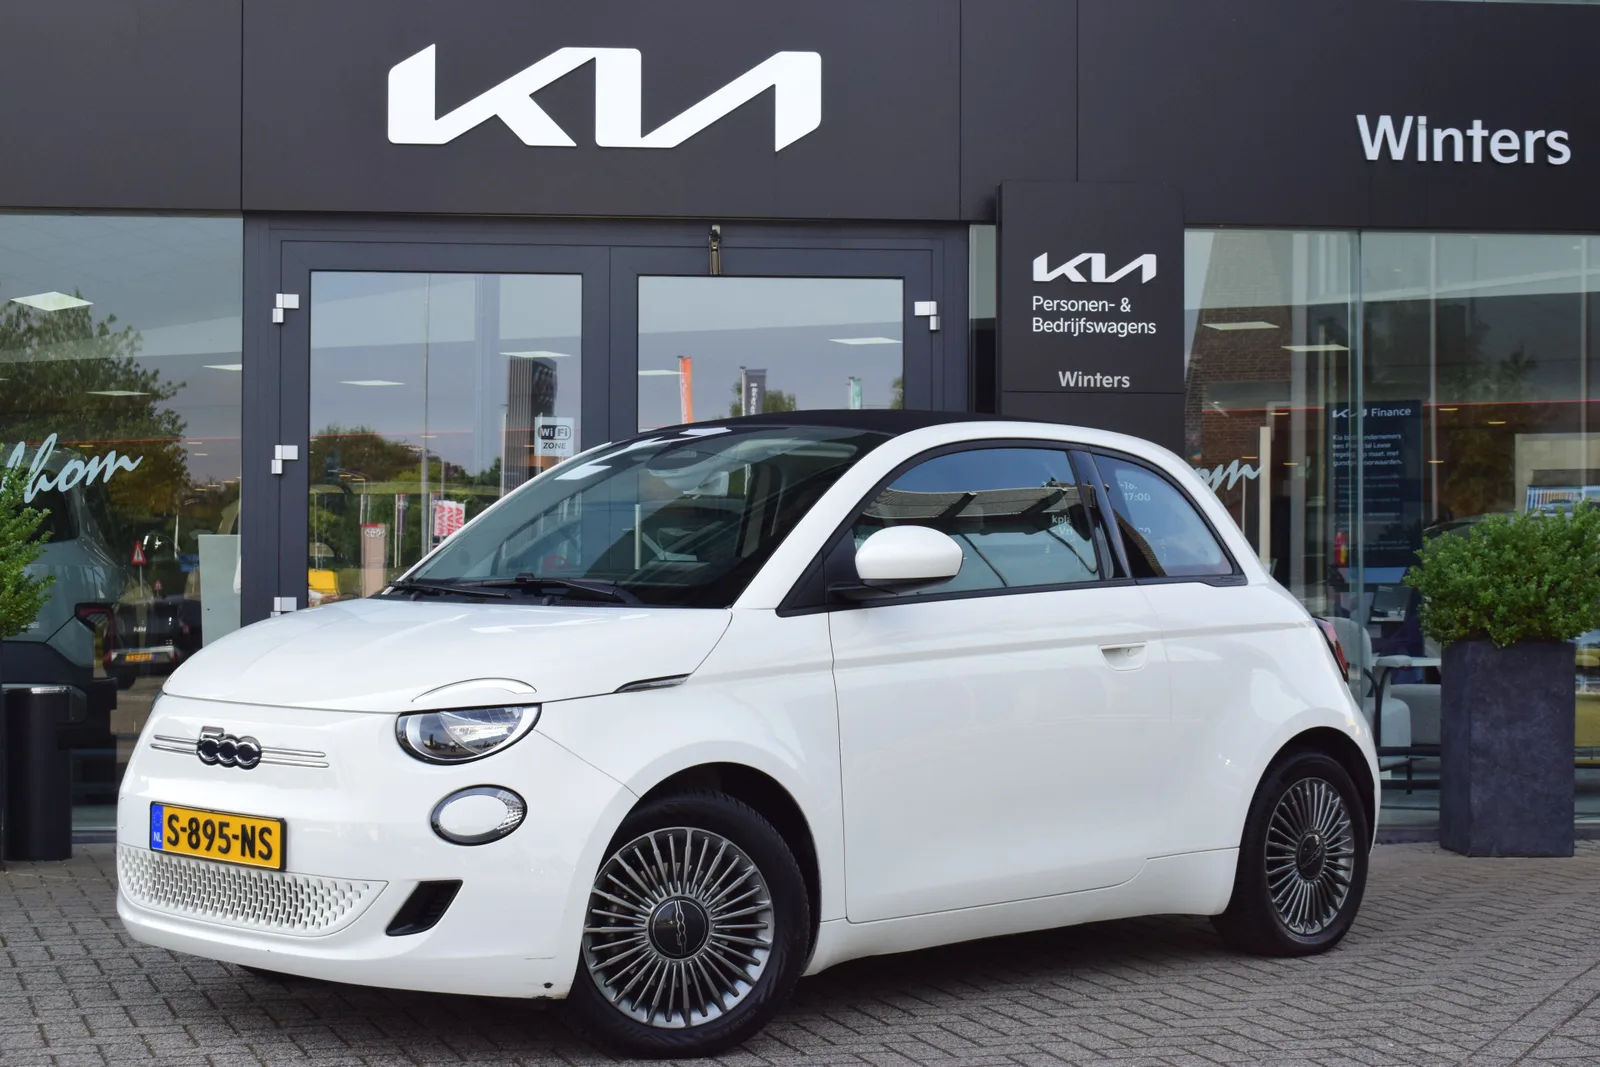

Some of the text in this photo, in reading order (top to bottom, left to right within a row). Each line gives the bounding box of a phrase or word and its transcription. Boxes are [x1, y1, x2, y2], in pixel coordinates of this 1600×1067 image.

[388, 44, 821, 151] KIA
[1356, 114, 1571, 165] Winters
[1033, 252, 1157, 284] KIA
[1032, 295, 1132, 312] Personen- &
[1032, 316, 1157, 338] Bedrijfswagens
[1058, 370, 1131, 388] Winters
[1371, 408, 1411, 417] Finance
[543, 442, 567, 450] ZONE
[1124, 493, 1151, 502] 17:00
[153, 831, 162, 843] NL
[167, 813, 273, 861] S-895-NS
